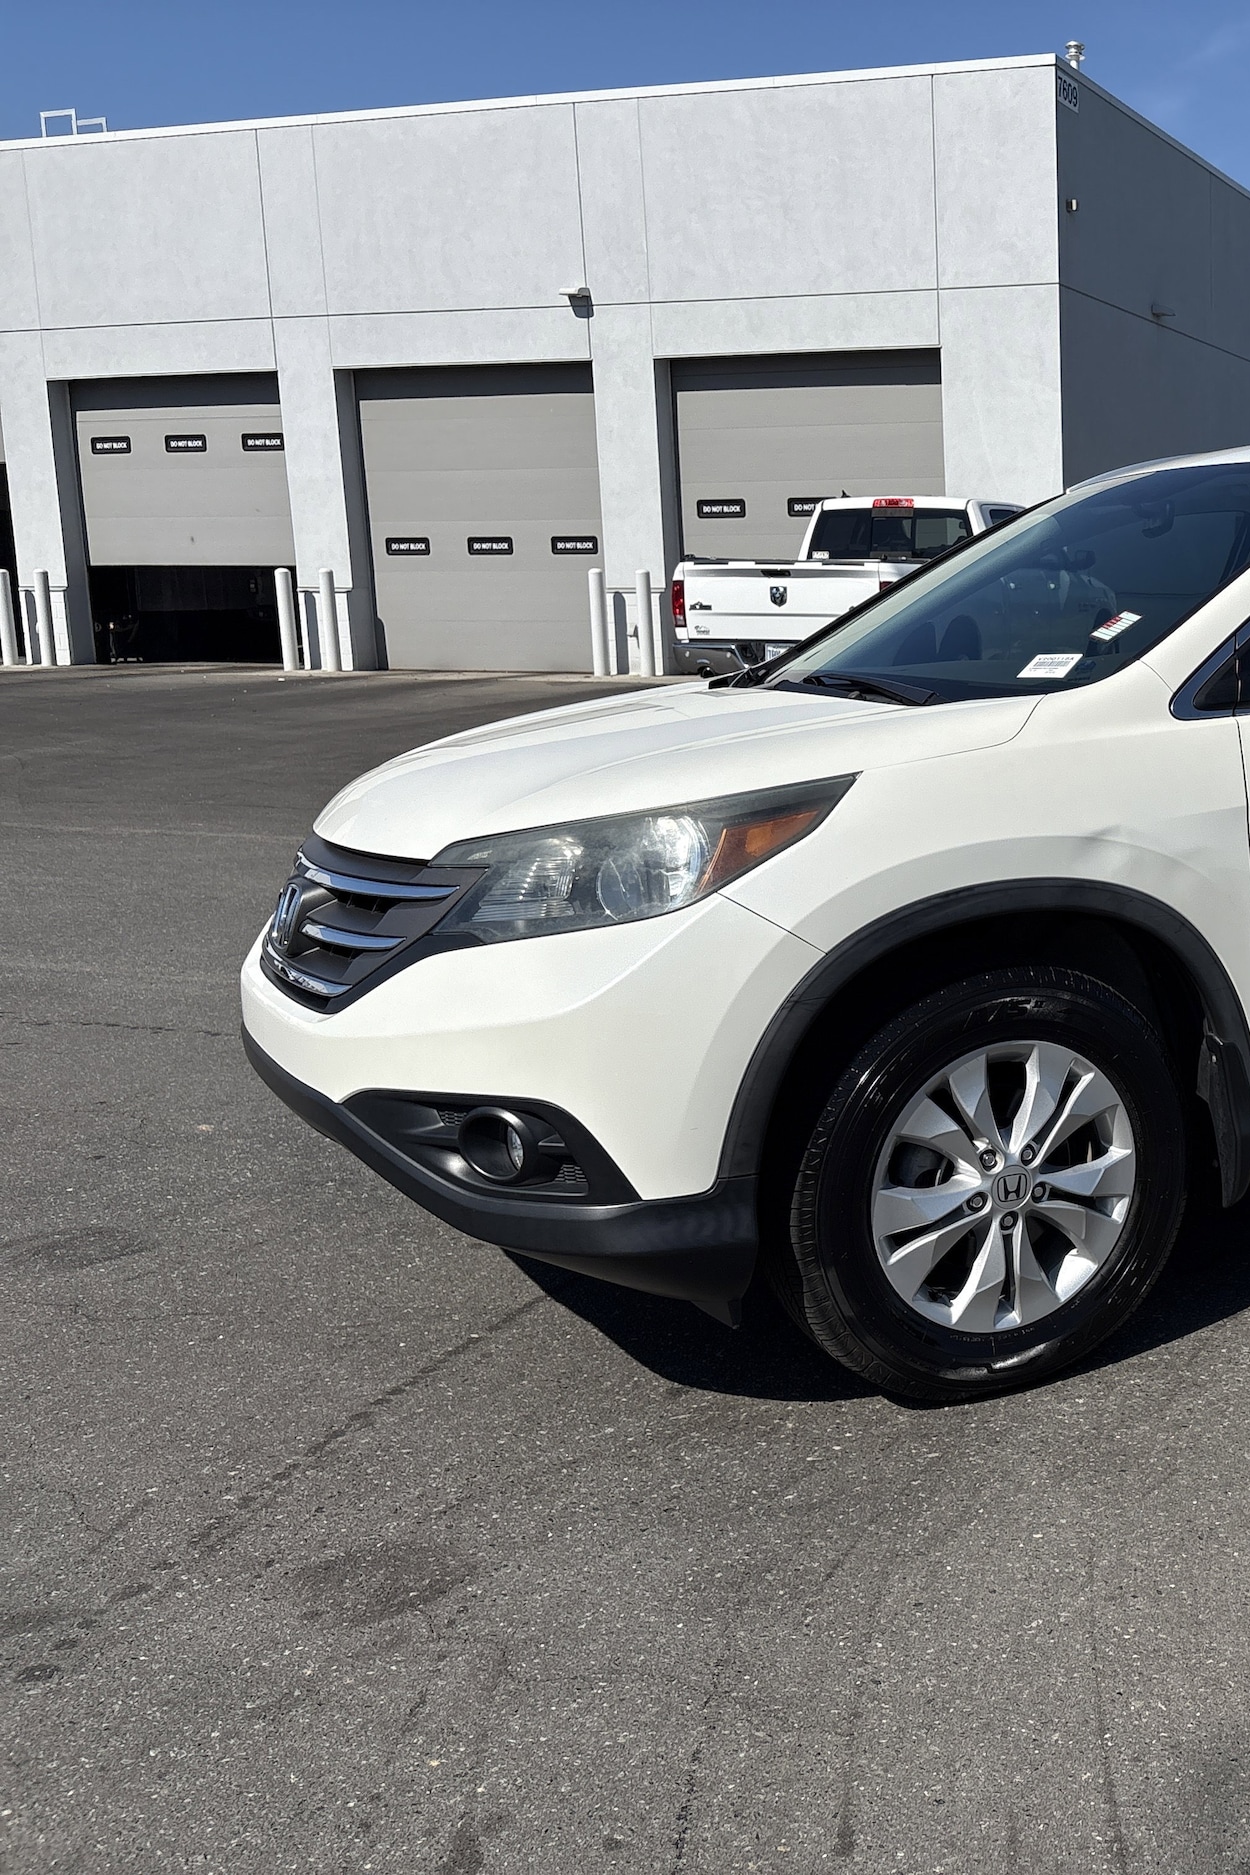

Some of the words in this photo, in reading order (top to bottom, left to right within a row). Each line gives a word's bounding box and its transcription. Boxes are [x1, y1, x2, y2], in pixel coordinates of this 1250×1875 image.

[1057, 76, 1078, 107] 7609
[95, 442, 104, 450] DO
[112, 441, 128, 449] BLOCK
[169, 440, 178, 448] DO
[246, 438, 255, 446] DO
[255, 438, 265, 446] NOT
[265, 438, 281, 446] BLOCK
[702, 505, 711, 513] DO
[711, 505, 723, 513] NOT
[793, 503, 803, 511] DO
[803, 503, 815, 511] NOT
[391, 543, 400, 551] DO
[410, 542, 427, 550] BLOCK
[481, 542, 492, 550] NOT
[492, 542, 509, 550] BLOCK
[565, 541, 576, 549] NOT
[576, 541, 594, 549] BLOCK
